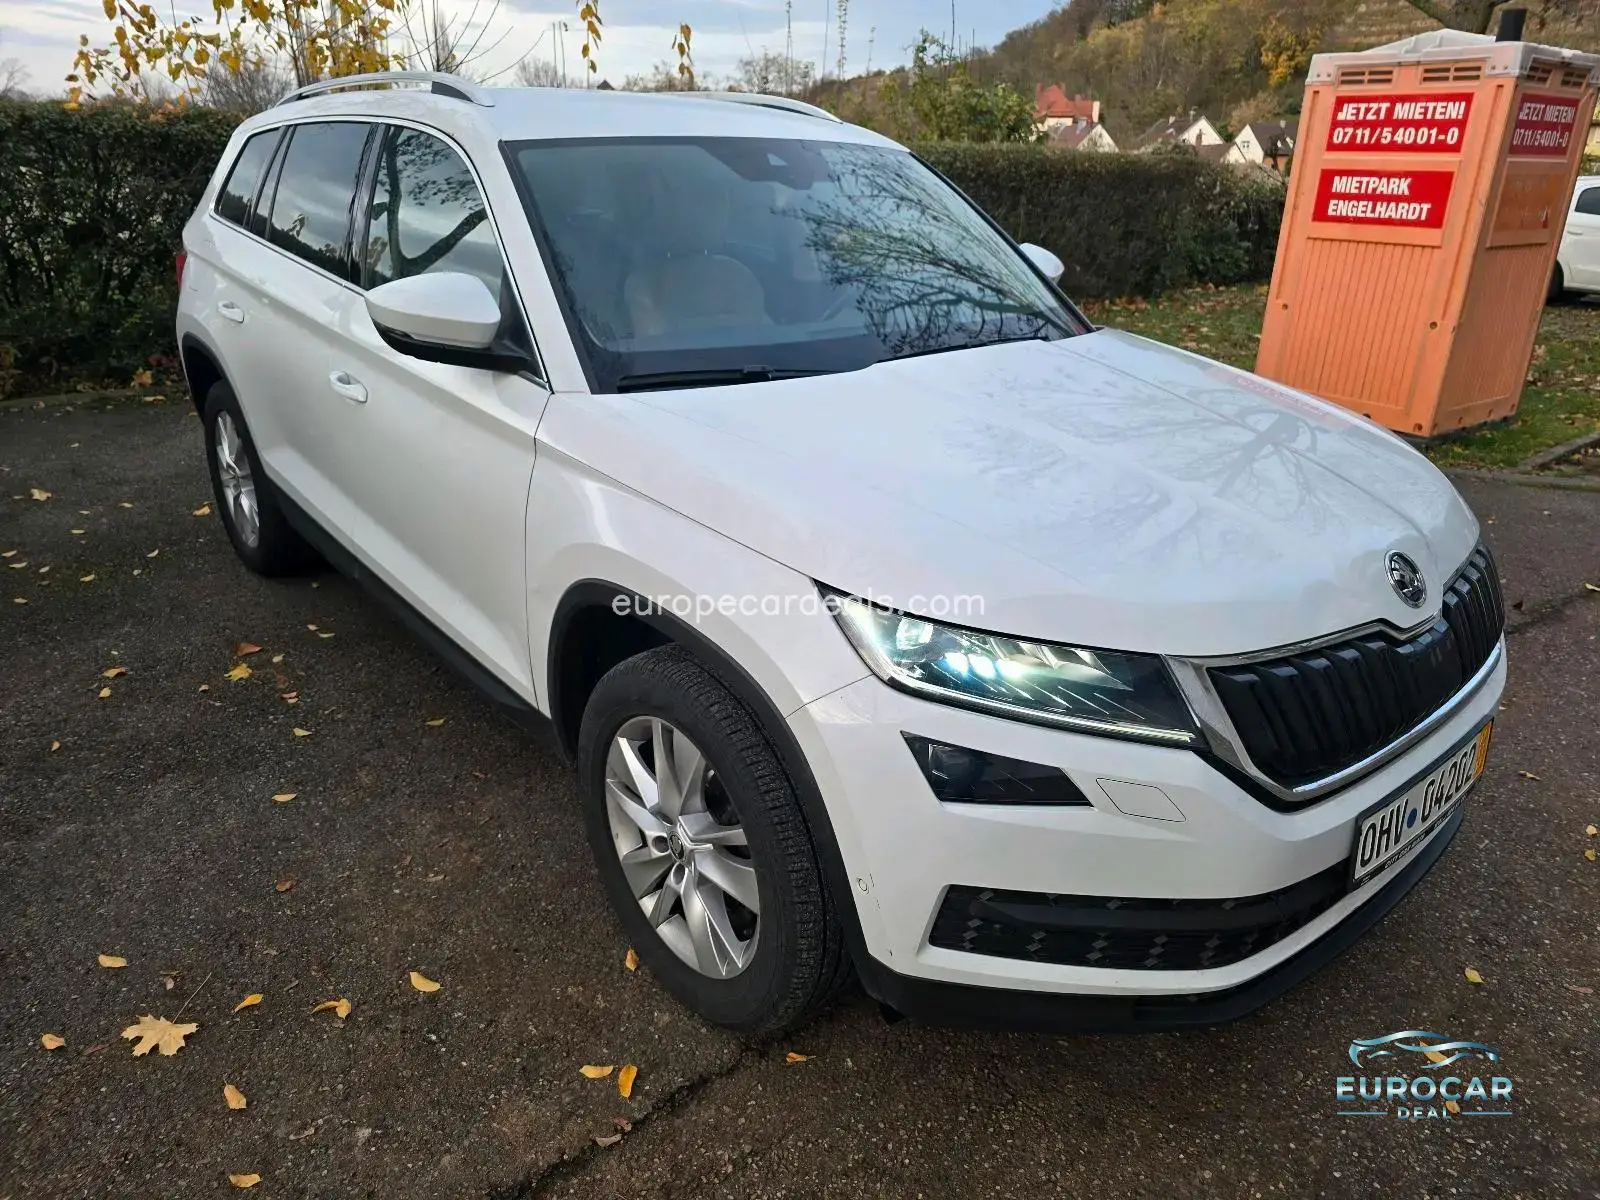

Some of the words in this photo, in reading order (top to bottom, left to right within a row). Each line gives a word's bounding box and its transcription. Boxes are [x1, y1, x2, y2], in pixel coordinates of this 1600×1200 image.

[1337, 103, 1390, 121] JETZT
[1394, 101, 1466, 119] MIETEN!
[1519, 102, 1545, 120] JETZT
[1544, 104, 1576, 123] MIETEN!
[1333, 127, 1459, 145] 0711/54001-0
[1332, 176, 1412, 196] MIETPARK
[1328, 199, 1432, 221] ENGELHARDT
[1359, 797, 1409, 868] OHV
[1420, 742, 1477, 823] 04202
